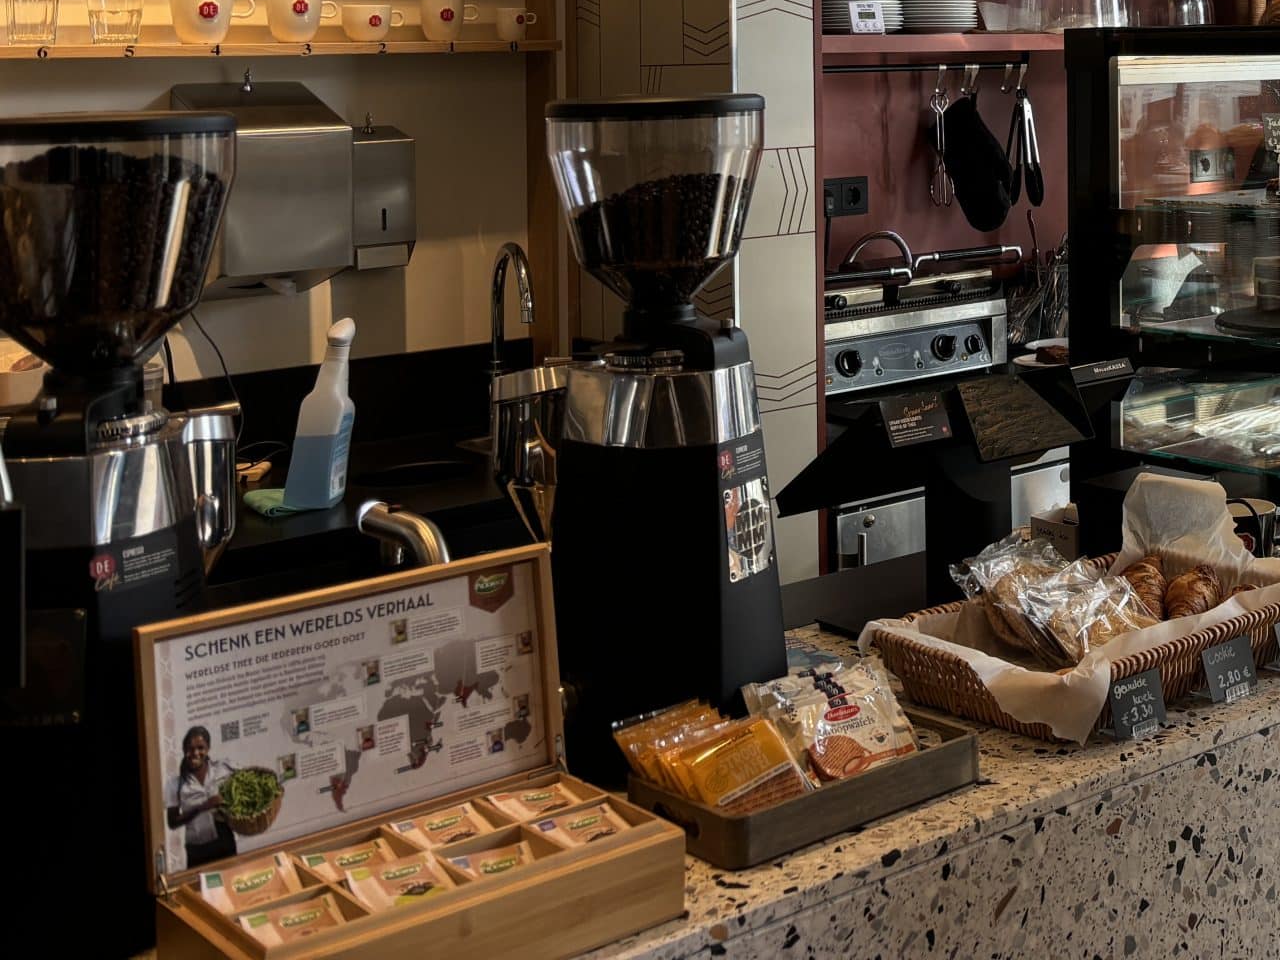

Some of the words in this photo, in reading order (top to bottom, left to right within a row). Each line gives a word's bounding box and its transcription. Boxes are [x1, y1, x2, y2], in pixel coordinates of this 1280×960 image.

[37, 46, 48, 59] 6
[124, 46, 135, 58] 5
[211, 44, 221, 56] 4
[302, 43, 312, 55] 3
[378, 43, 387, 54] 2
[185, 637, 251, 662] SCHENK
[255, 625, 286, 645] EEN
[290, 608, 364, 635] WERELDS
[367, 593, 434, 620] VERHAAL
[185, 666, 230, 681] WERELDSE
[232, 658, 254, 670] THEE
[255, 654, 269, 664] DIE
[271, 644, 313, 662] IEDEREEN
[314, 638, 341, 651] GOED
[343, 632, 366, 645] DOET
[1207, 643, 1236, 665] Cookie
[1218, 669, 1241, 689] 2,80
[1132, 689, 1156, 705] koek
